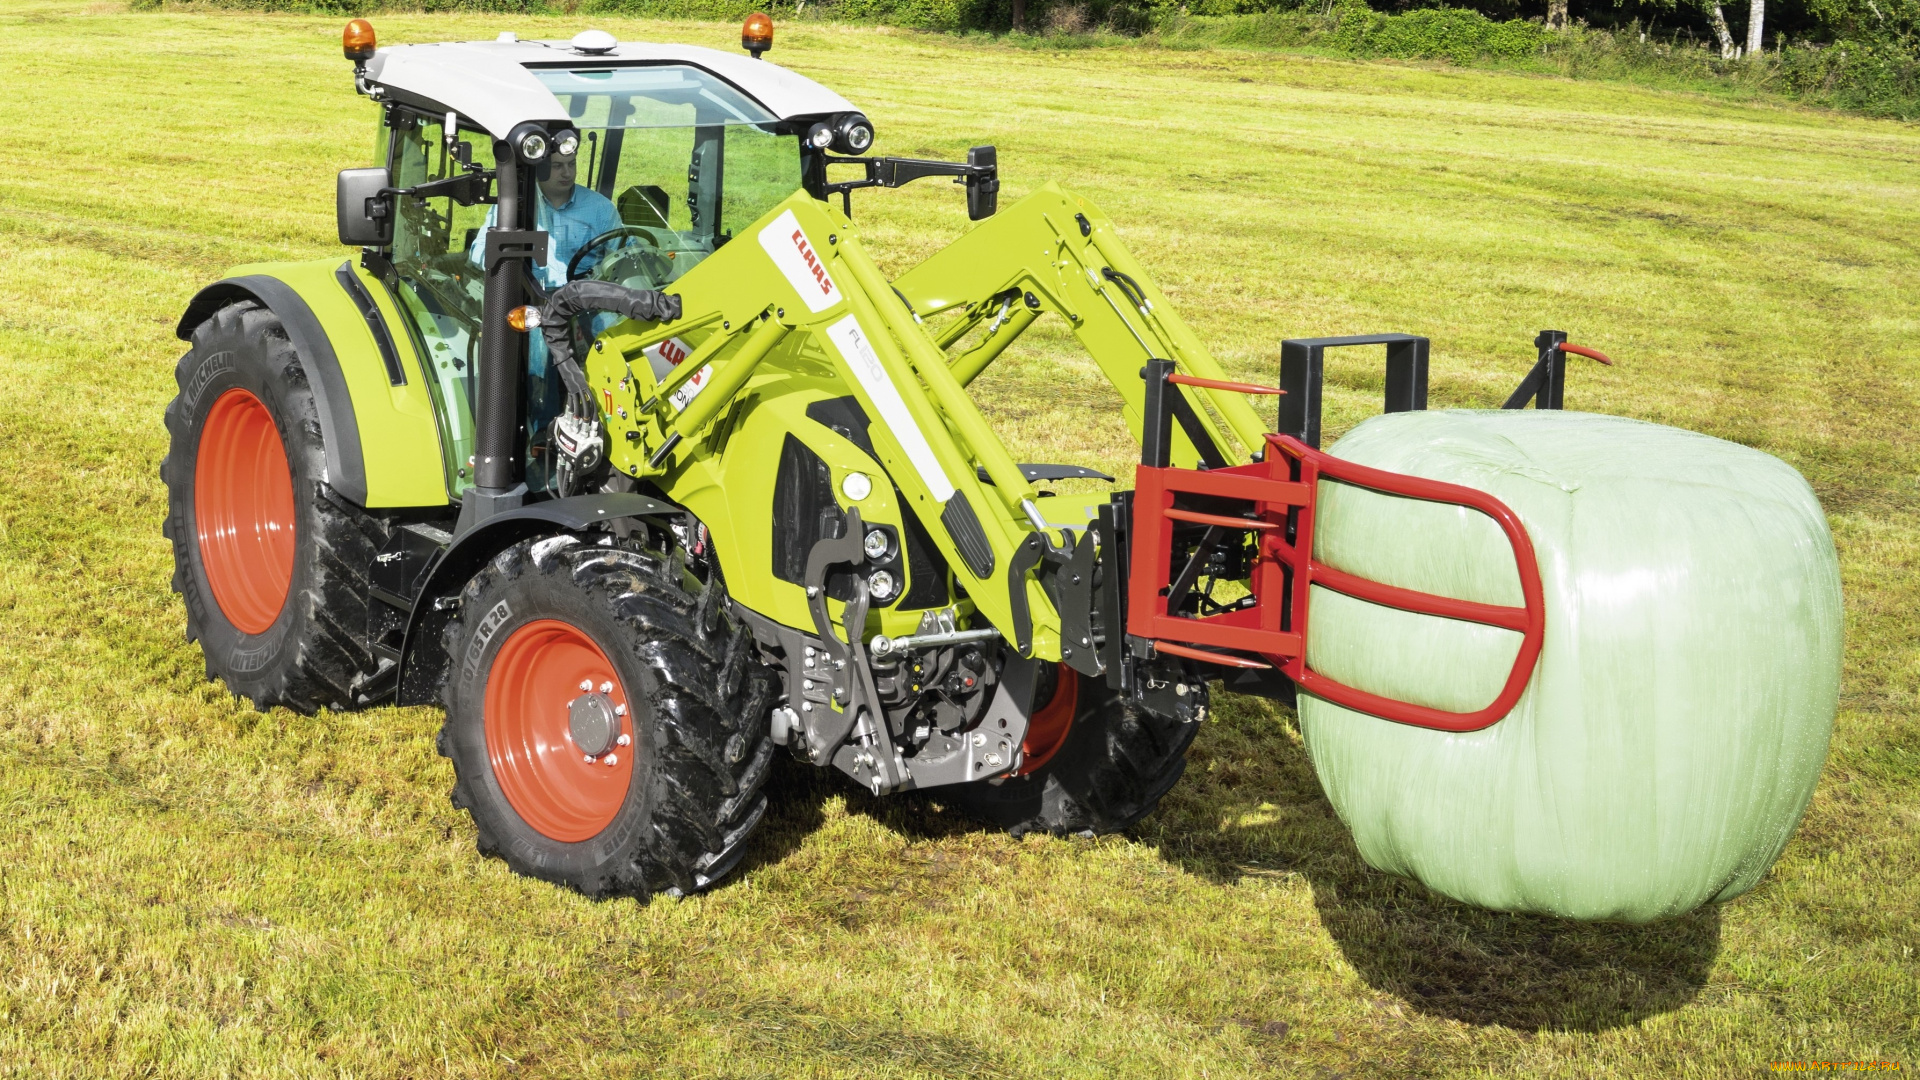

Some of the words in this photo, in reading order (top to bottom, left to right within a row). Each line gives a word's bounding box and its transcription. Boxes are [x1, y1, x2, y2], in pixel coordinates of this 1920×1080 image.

[792, 230, 832, 295] CLAAS
[188, 352, 235, 402] MICHELIN
[659, 339, 704, 386] CLAS
[480, 621, 493, 639] R
[490, 604, 508, 626] 28
